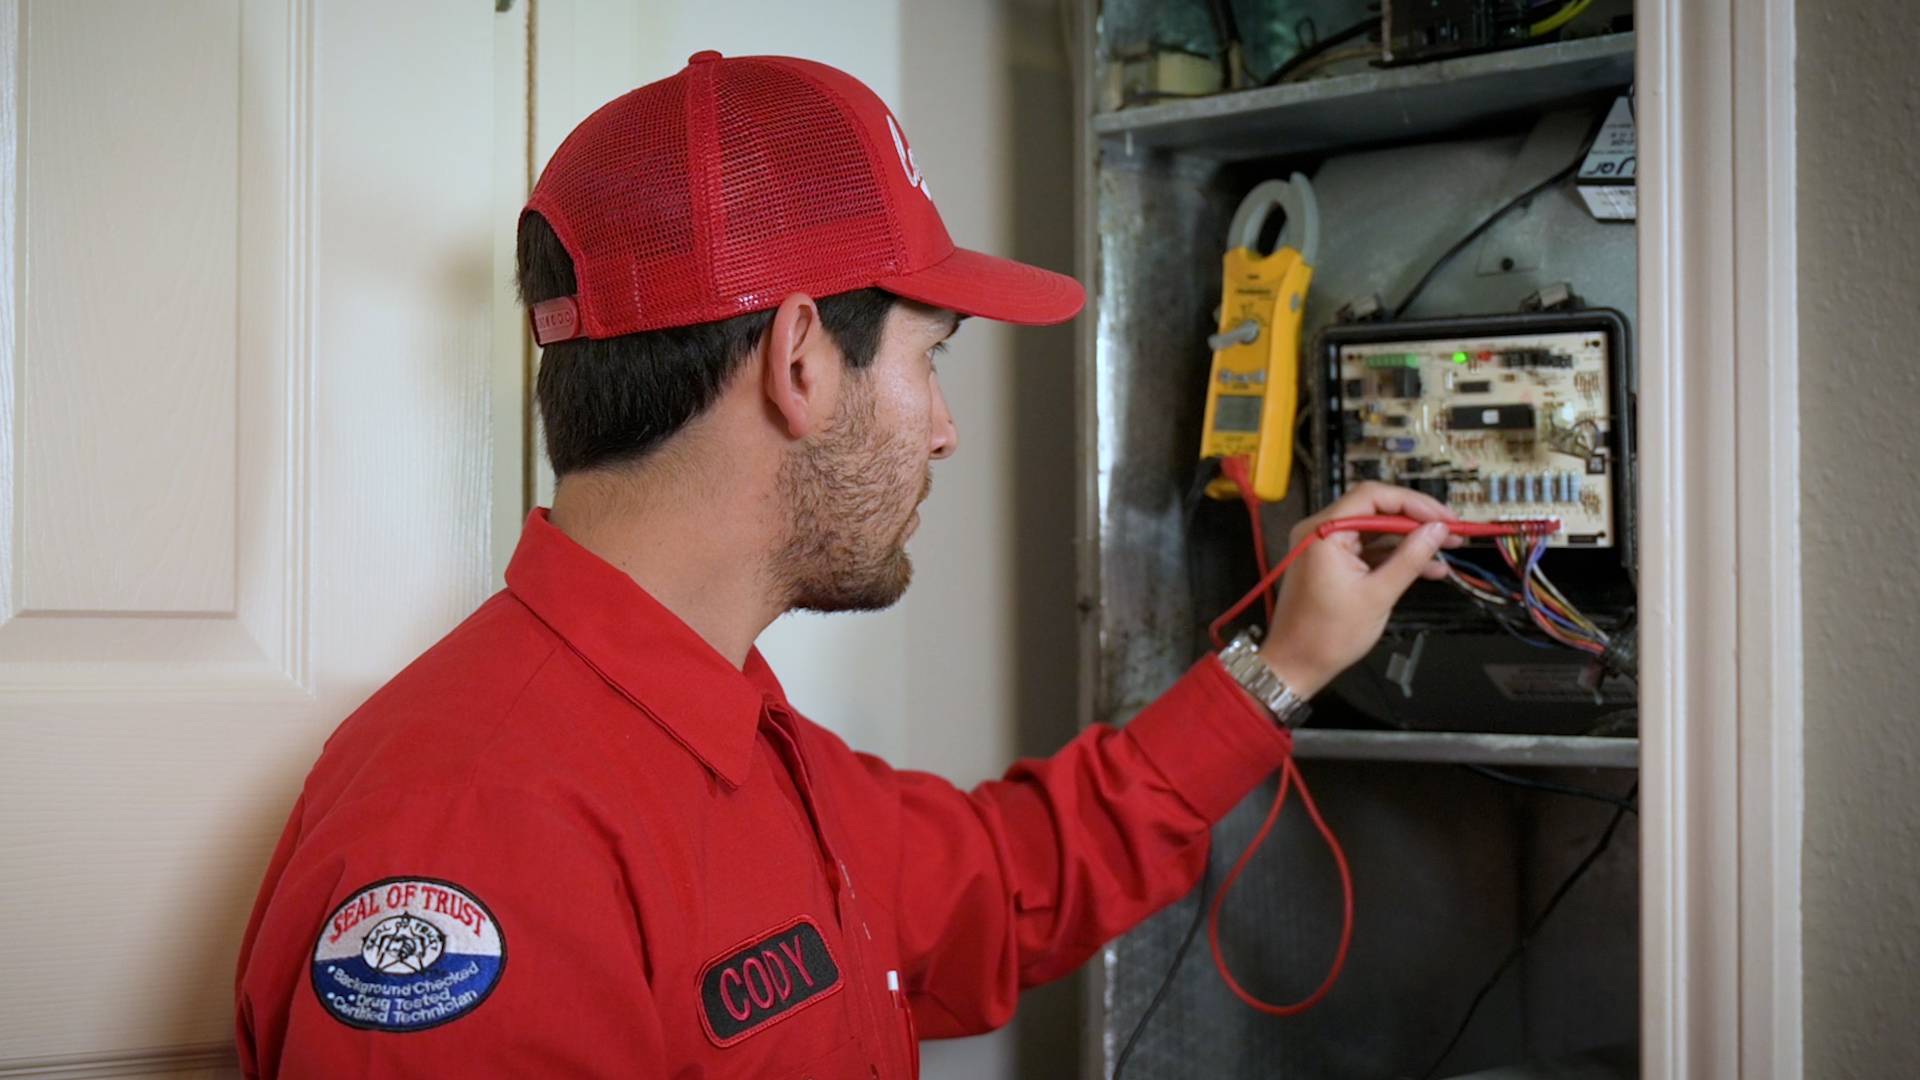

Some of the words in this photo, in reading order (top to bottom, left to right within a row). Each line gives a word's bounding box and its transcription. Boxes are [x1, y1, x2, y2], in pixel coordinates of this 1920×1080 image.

[329, 892, 380, 943] SEAL
[386, 884, 417, 908] OF
[421, 887, 486, 936] TRUST
[334, 968, 411, 996] Background
[413, 960, 479, 994] Checked
[720, 935, 814, 1021] CODY
[333, 995, 388, 1022] Certified
[393, 989, 478, 1022] Technician
[355, 994, 390, 1009] Drug
[395, 988, 450, 1010] Tested
